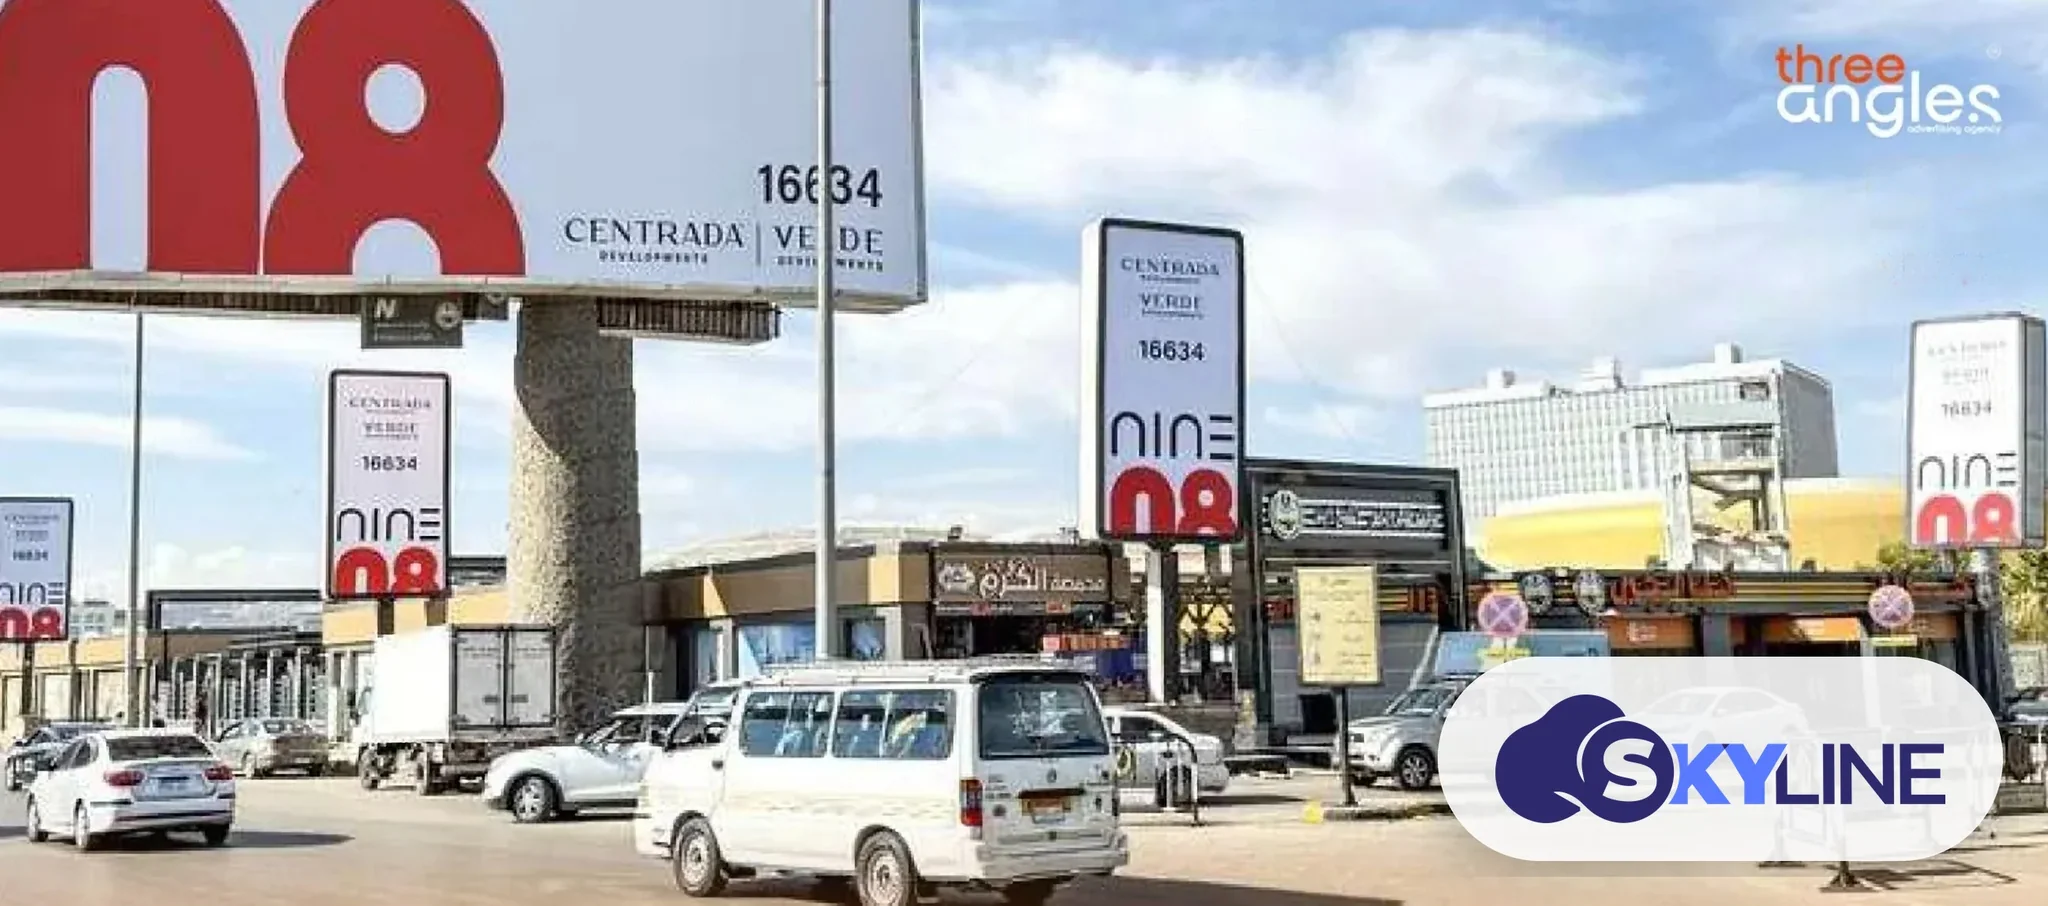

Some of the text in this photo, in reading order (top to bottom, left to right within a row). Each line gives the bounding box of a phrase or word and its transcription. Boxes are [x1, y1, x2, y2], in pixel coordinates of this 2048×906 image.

[564, 217, 884, 254] CENTRADA VEDE
[1139, 340, 1205, 361] 16634
